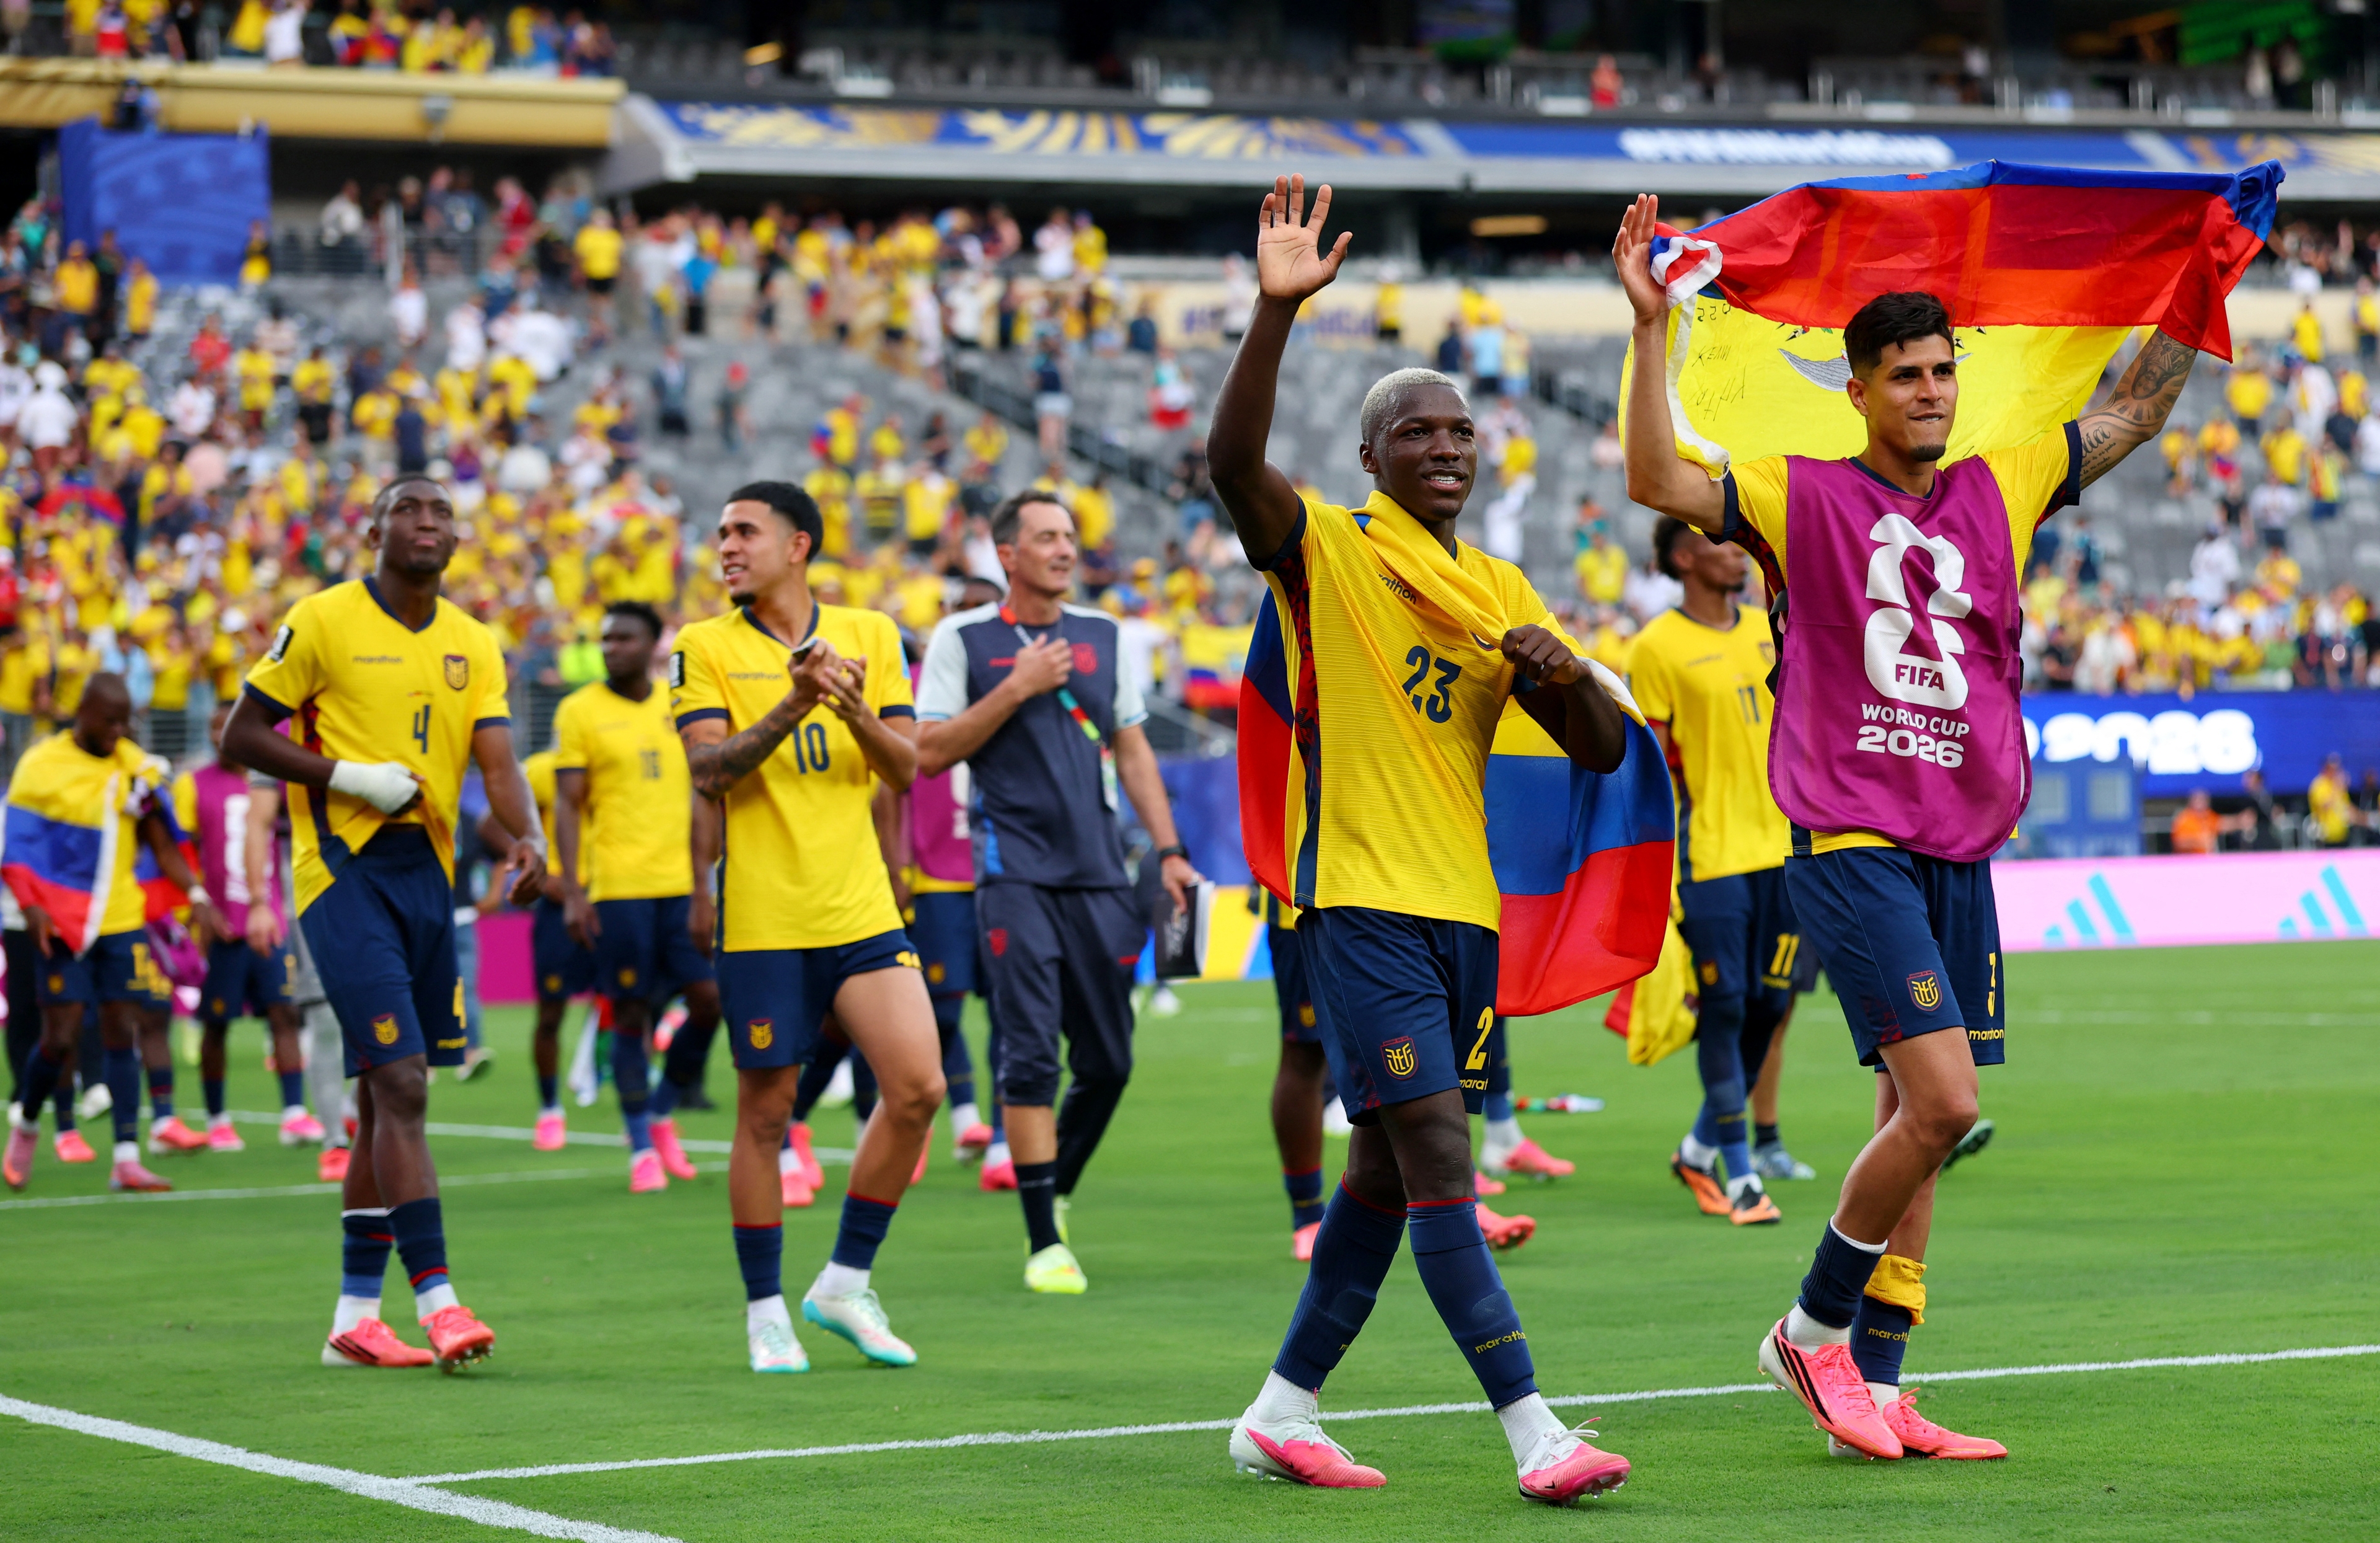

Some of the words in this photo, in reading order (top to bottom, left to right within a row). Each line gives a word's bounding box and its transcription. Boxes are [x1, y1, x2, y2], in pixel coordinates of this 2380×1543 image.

[1401, 645, 1463, 724] 23
[1895, 663, 1945, 692] FIFA
[412, 704, 431, 754] 4
[1861, 703, 1928, 730] WORLD
[1929, 716, 1971, 738] CUP
[792, 722, 831, 775] 10
[1856, 725, 1965, 769] 2026
[1770, 932, 1800, 978] 11
